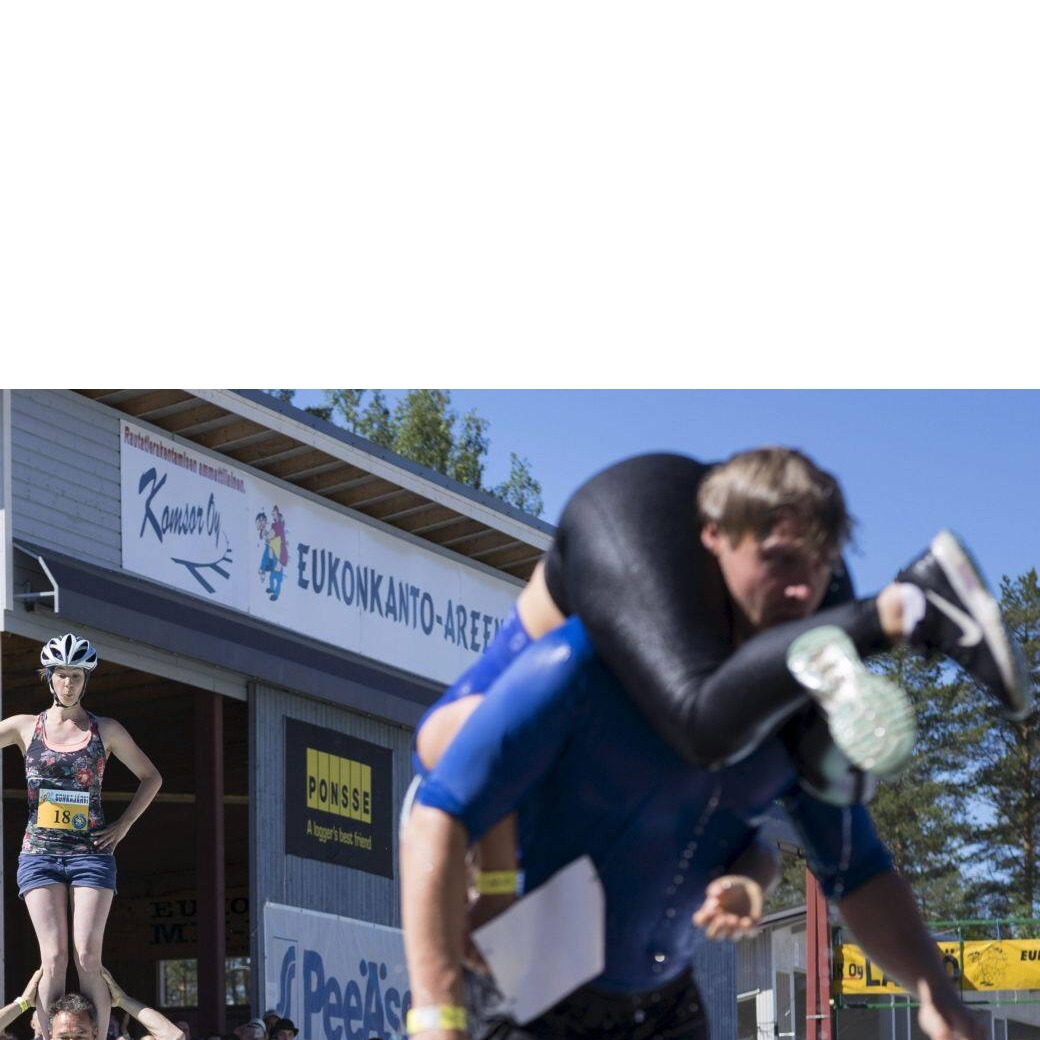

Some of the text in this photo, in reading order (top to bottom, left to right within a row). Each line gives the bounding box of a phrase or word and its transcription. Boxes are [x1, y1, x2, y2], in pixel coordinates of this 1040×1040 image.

[207, 492, 220, 549] Oy
[309, 775, 370, 815] PONSSE
[54, 810, 70, 824] 18
[339, 826, 353, 845] best
